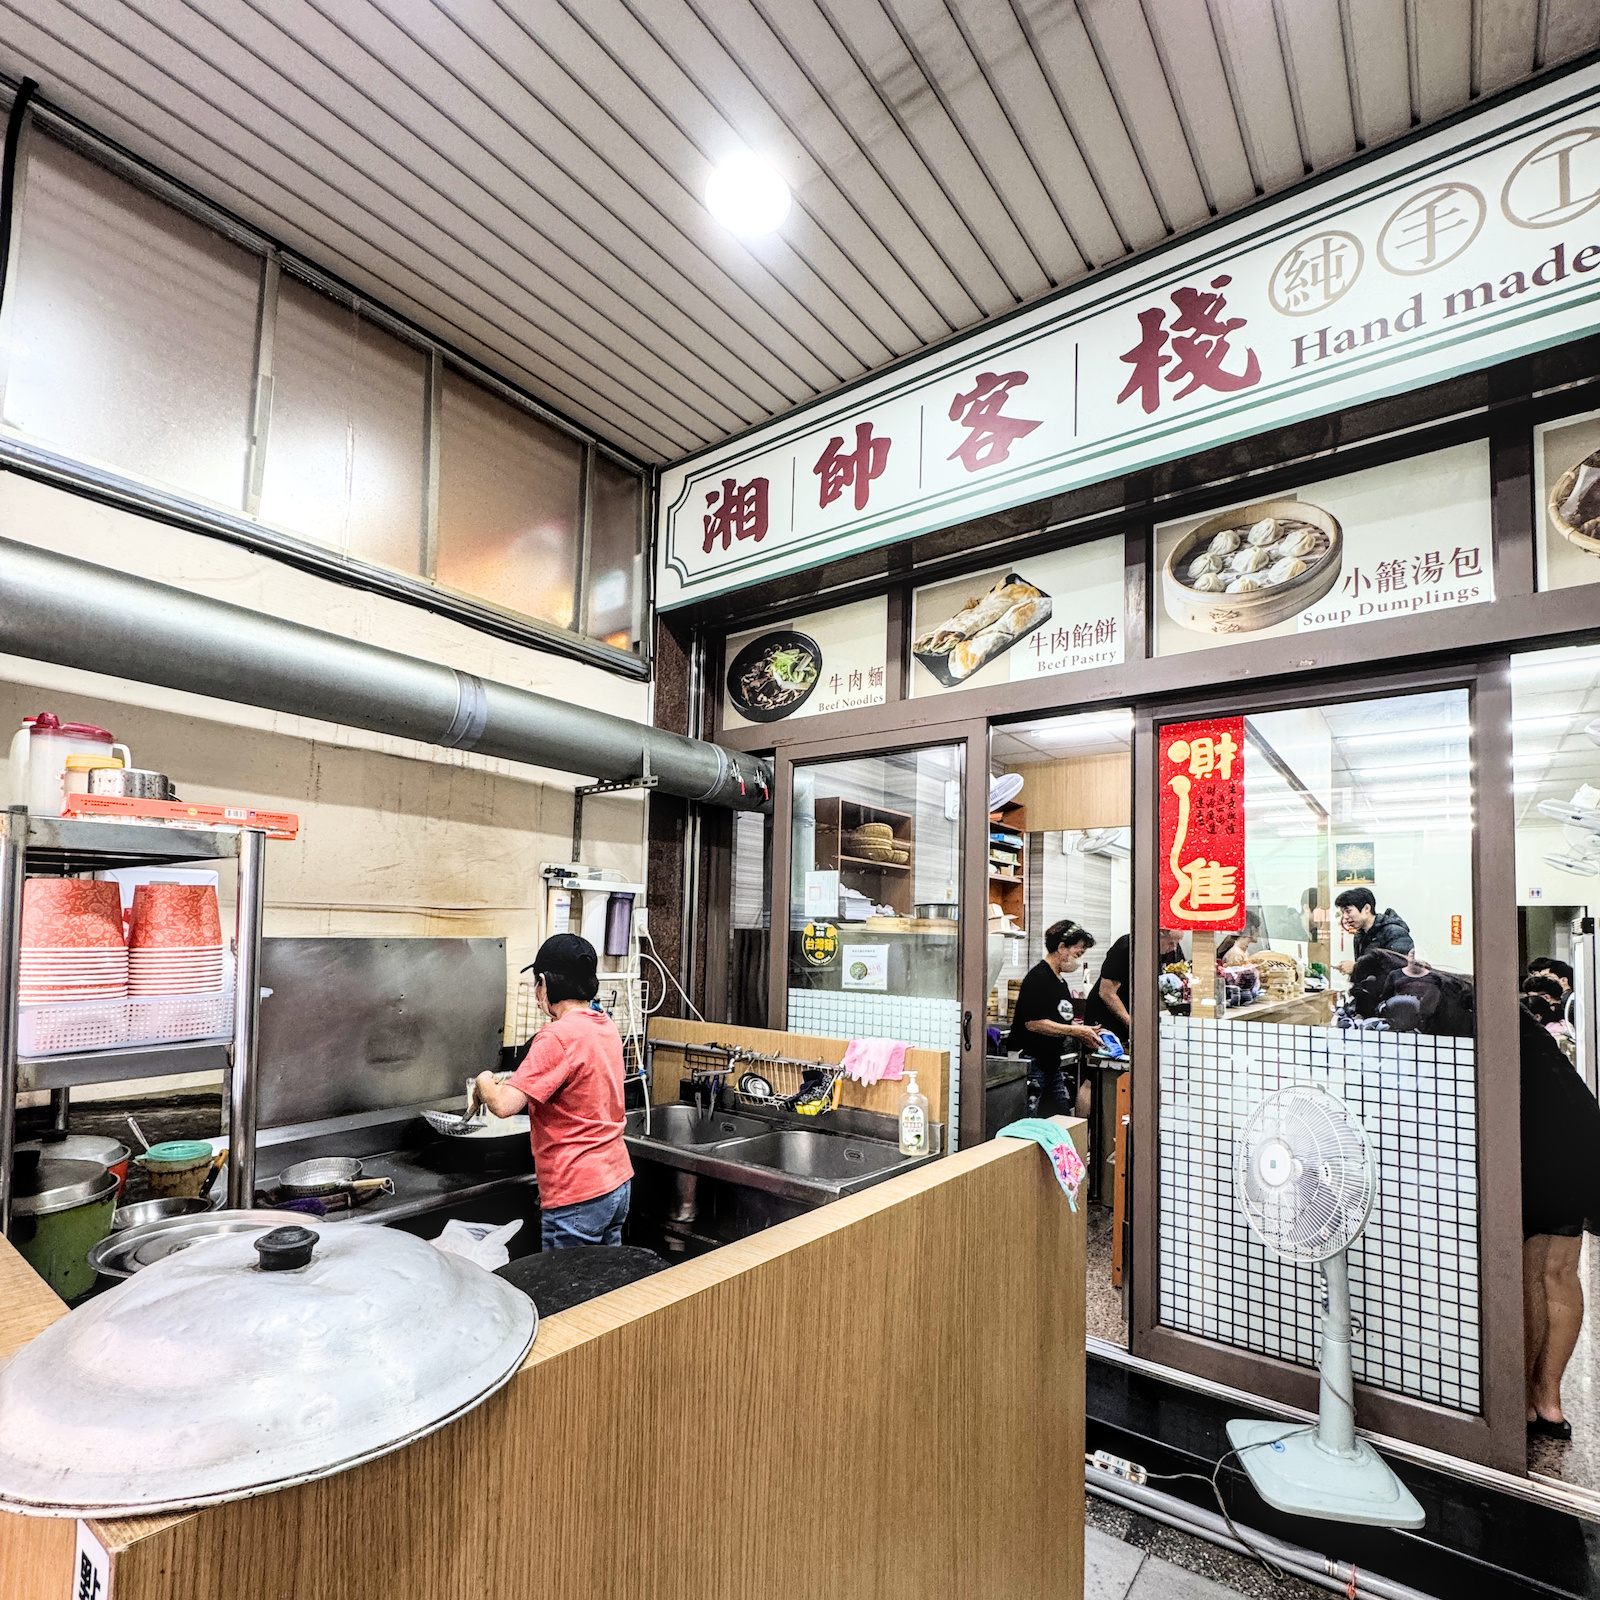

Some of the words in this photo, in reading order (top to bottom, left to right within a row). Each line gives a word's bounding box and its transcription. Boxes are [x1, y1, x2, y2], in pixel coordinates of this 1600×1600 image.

[1284, 132, 1600, 310] 純手工
[1291, 296, 1428, 370] Hand
[1443, 242, 1600, 320] made
[702, 274, 1262, 554] 湘帥客棧
[1342, 547, 1483, 598] 小籠湯包
[1303, 609, 1352, 626] Soup
[1358, 586, 1480, 617] Dumplings
[1029, 617, 1117, 657] 牛肉餡餅
[829, 666, 884, 695] 牛肉麵
[1038, 656, 1068, 672] Beef
[1072, 651, 1116, 666] Pastry
[819, 699, 840, 712] Beef
[842, 694, 883, 708] Noodles
